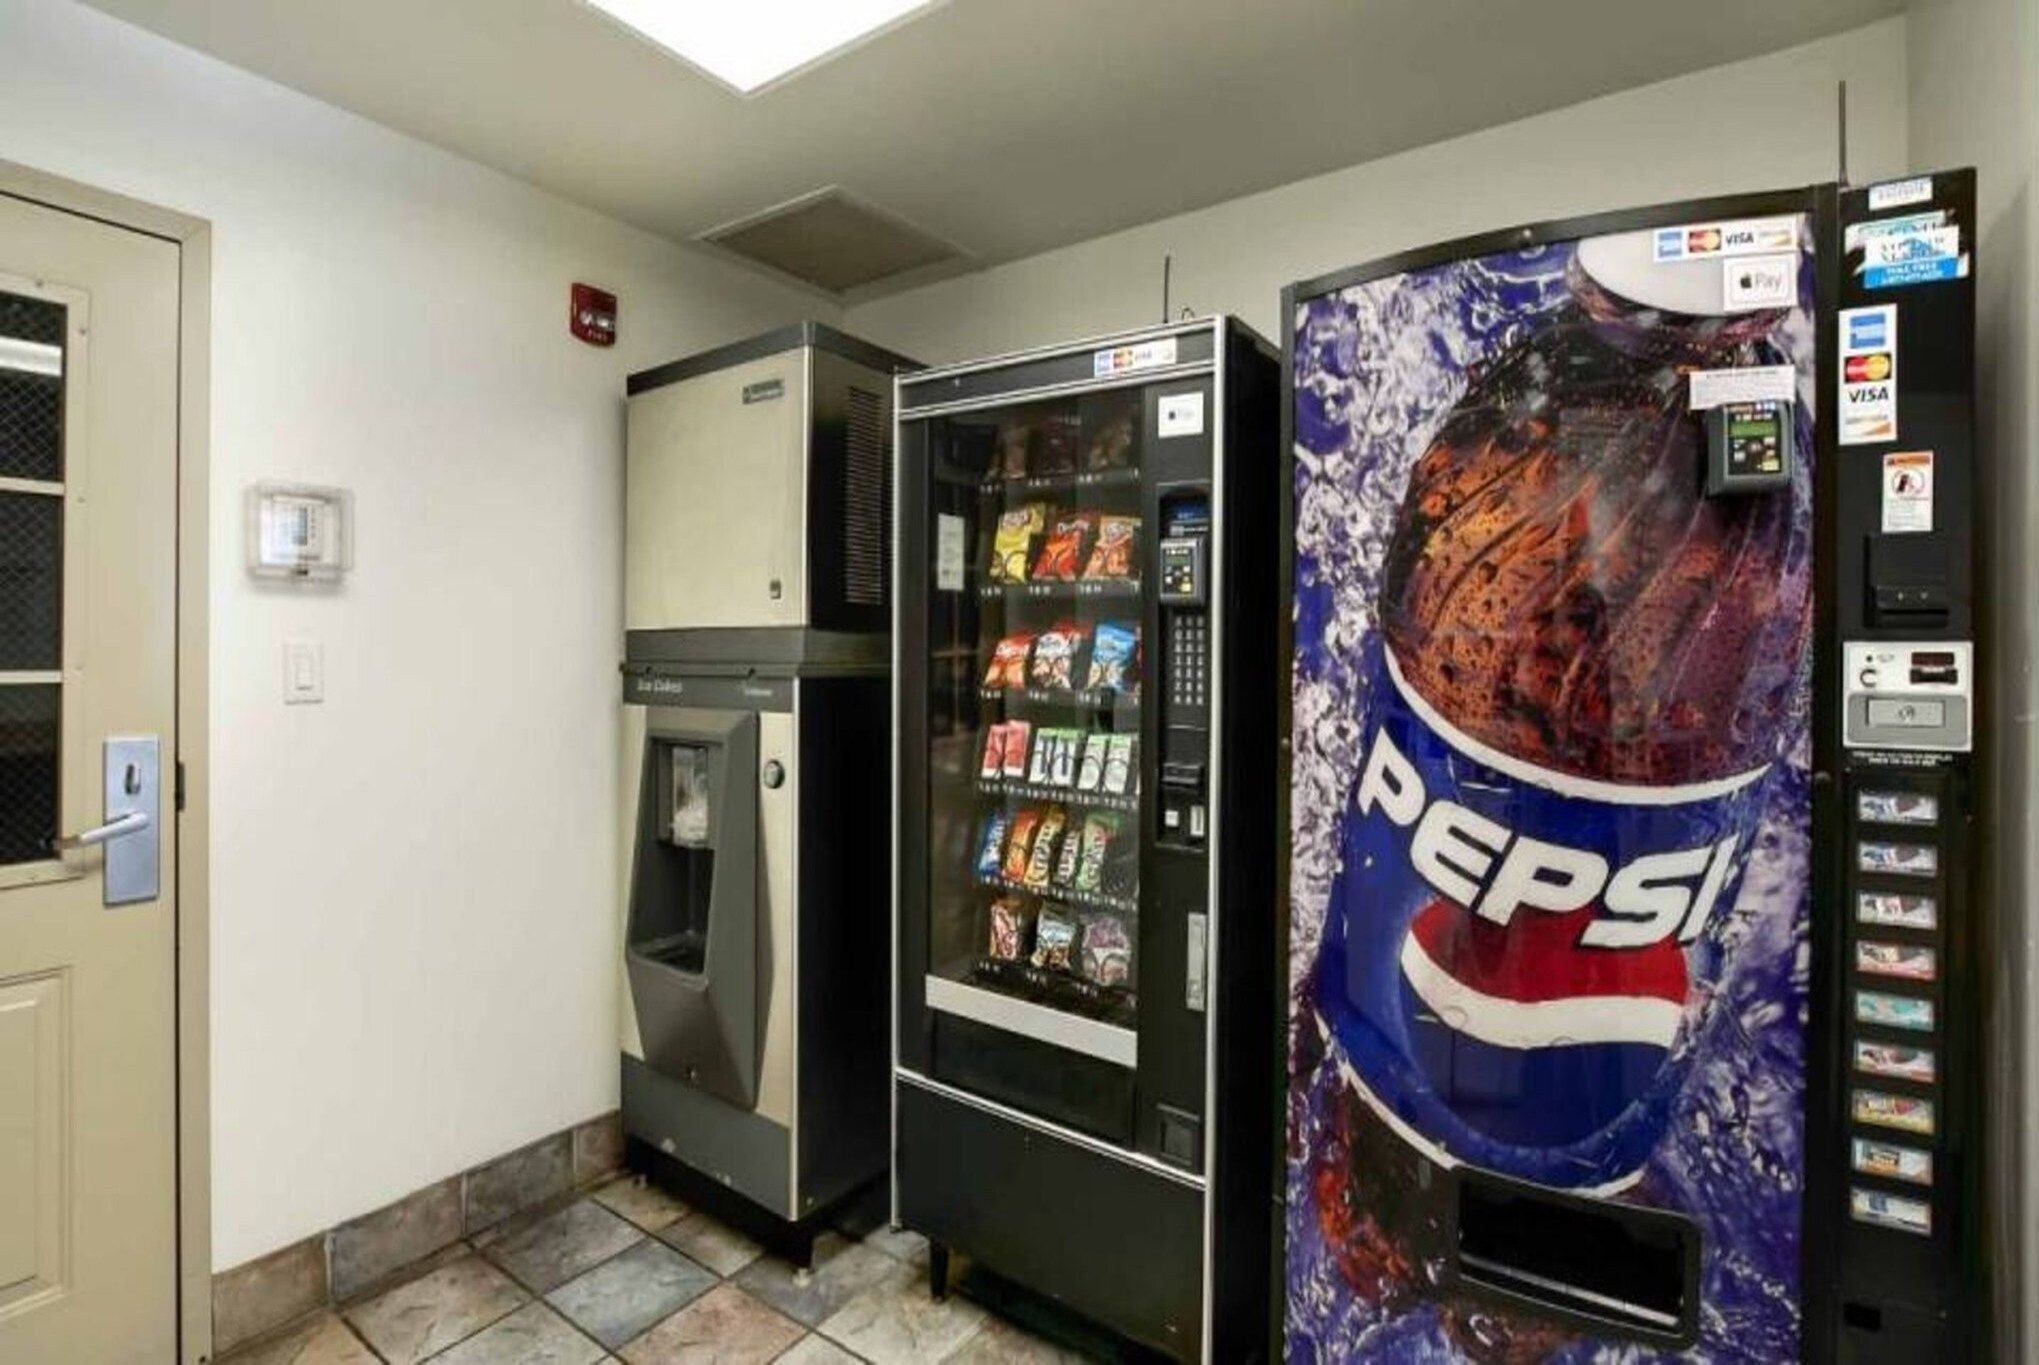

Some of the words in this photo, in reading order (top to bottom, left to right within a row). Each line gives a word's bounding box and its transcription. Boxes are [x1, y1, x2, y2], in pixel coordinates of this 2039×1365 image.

[1725, 231, 1755, 247] VISA
[1755, 272, 1783, 291] Pay
[1848, 386, 1890, 404] VISA
[1358, 727, 1740, 949] PEPSI
